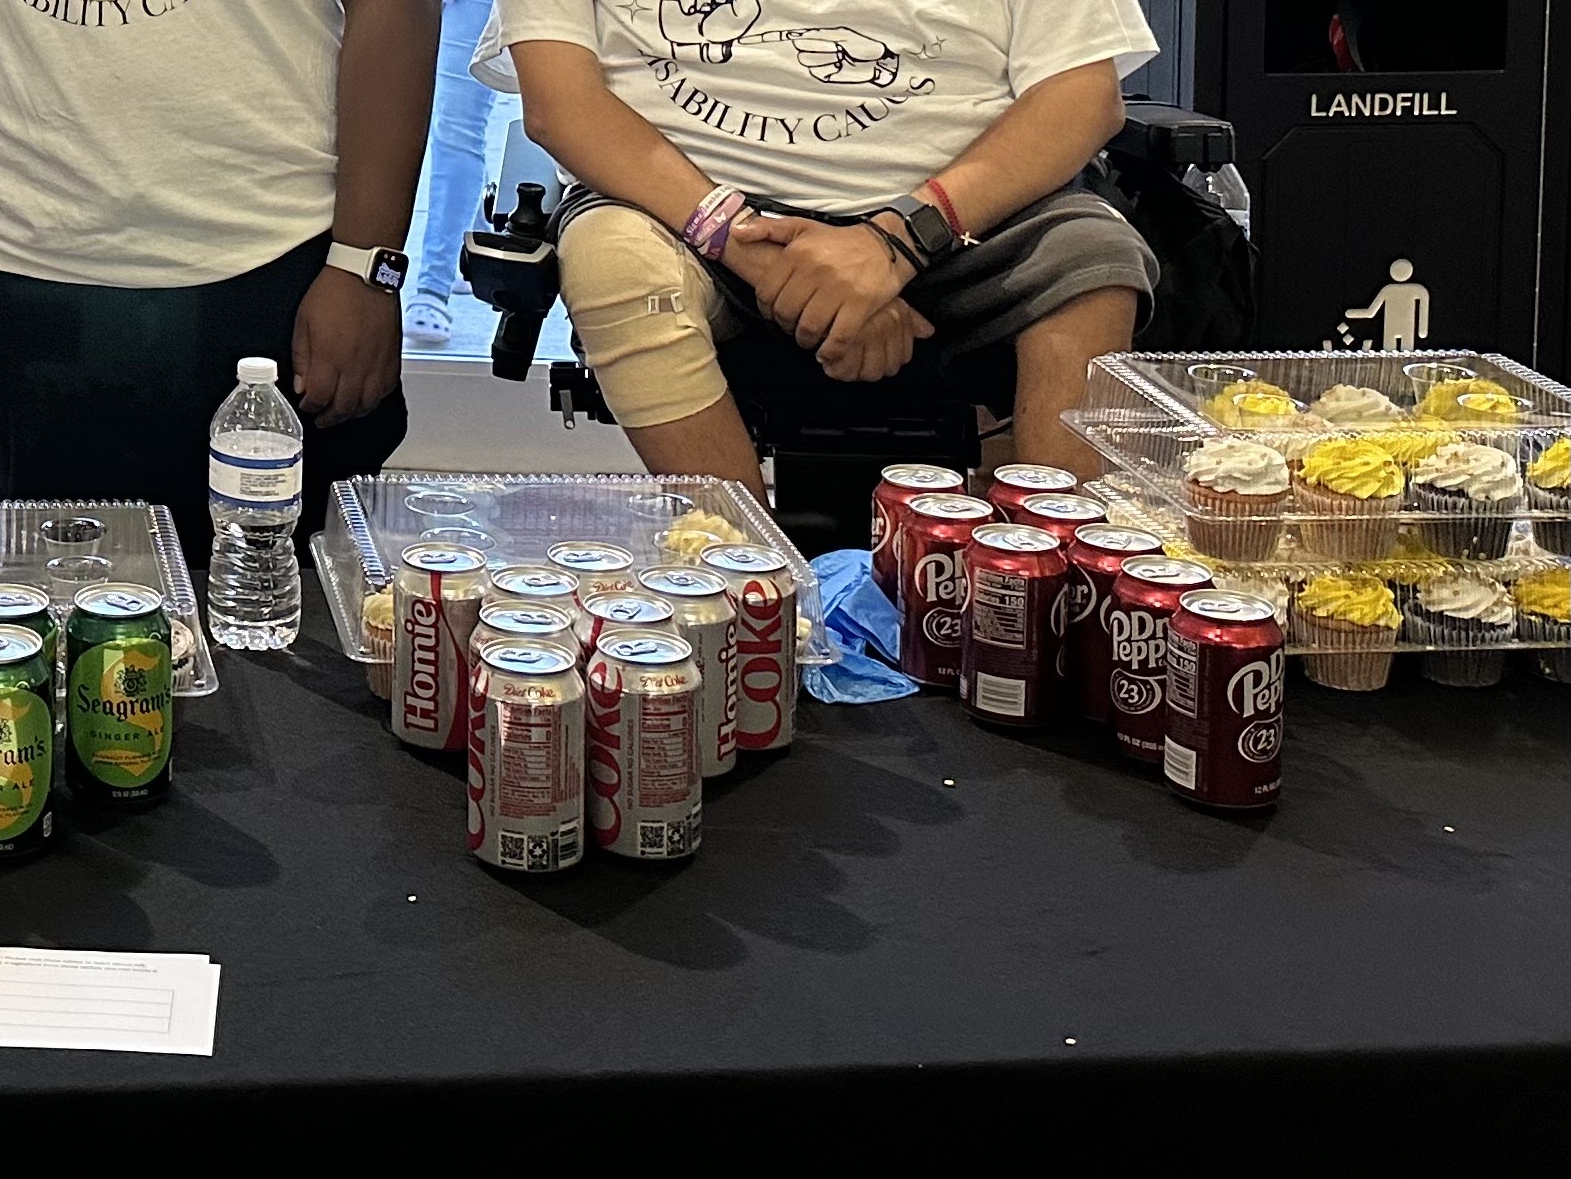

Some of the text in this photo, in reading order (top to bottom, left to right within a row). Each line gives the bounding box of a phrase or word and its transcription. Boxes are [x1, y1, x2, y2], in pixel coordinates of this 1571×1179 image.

[1310, 91, 1458, 117] LANDFILL
[1004, 596, 1025, 608] 150
[1130, 610, 1170, 641] Dr
[1110, 610, 1167, 670] Pepp
[404, 598, 439, 733] Homie
[735, 578, 783, 749] Coke
[503, 684, 556, 699] Diet Coke
[664, 675, 689, 688] Coke
[1119, 680, 1139, 703] 23
[76, 683, 171, 722] Seagram's
[89, 730, 141, 742] GINGER
[1256, 728, 1275, 751] 23
[586, 661, 622, 847] Coke
[12, 777, 34, 790] ALE
